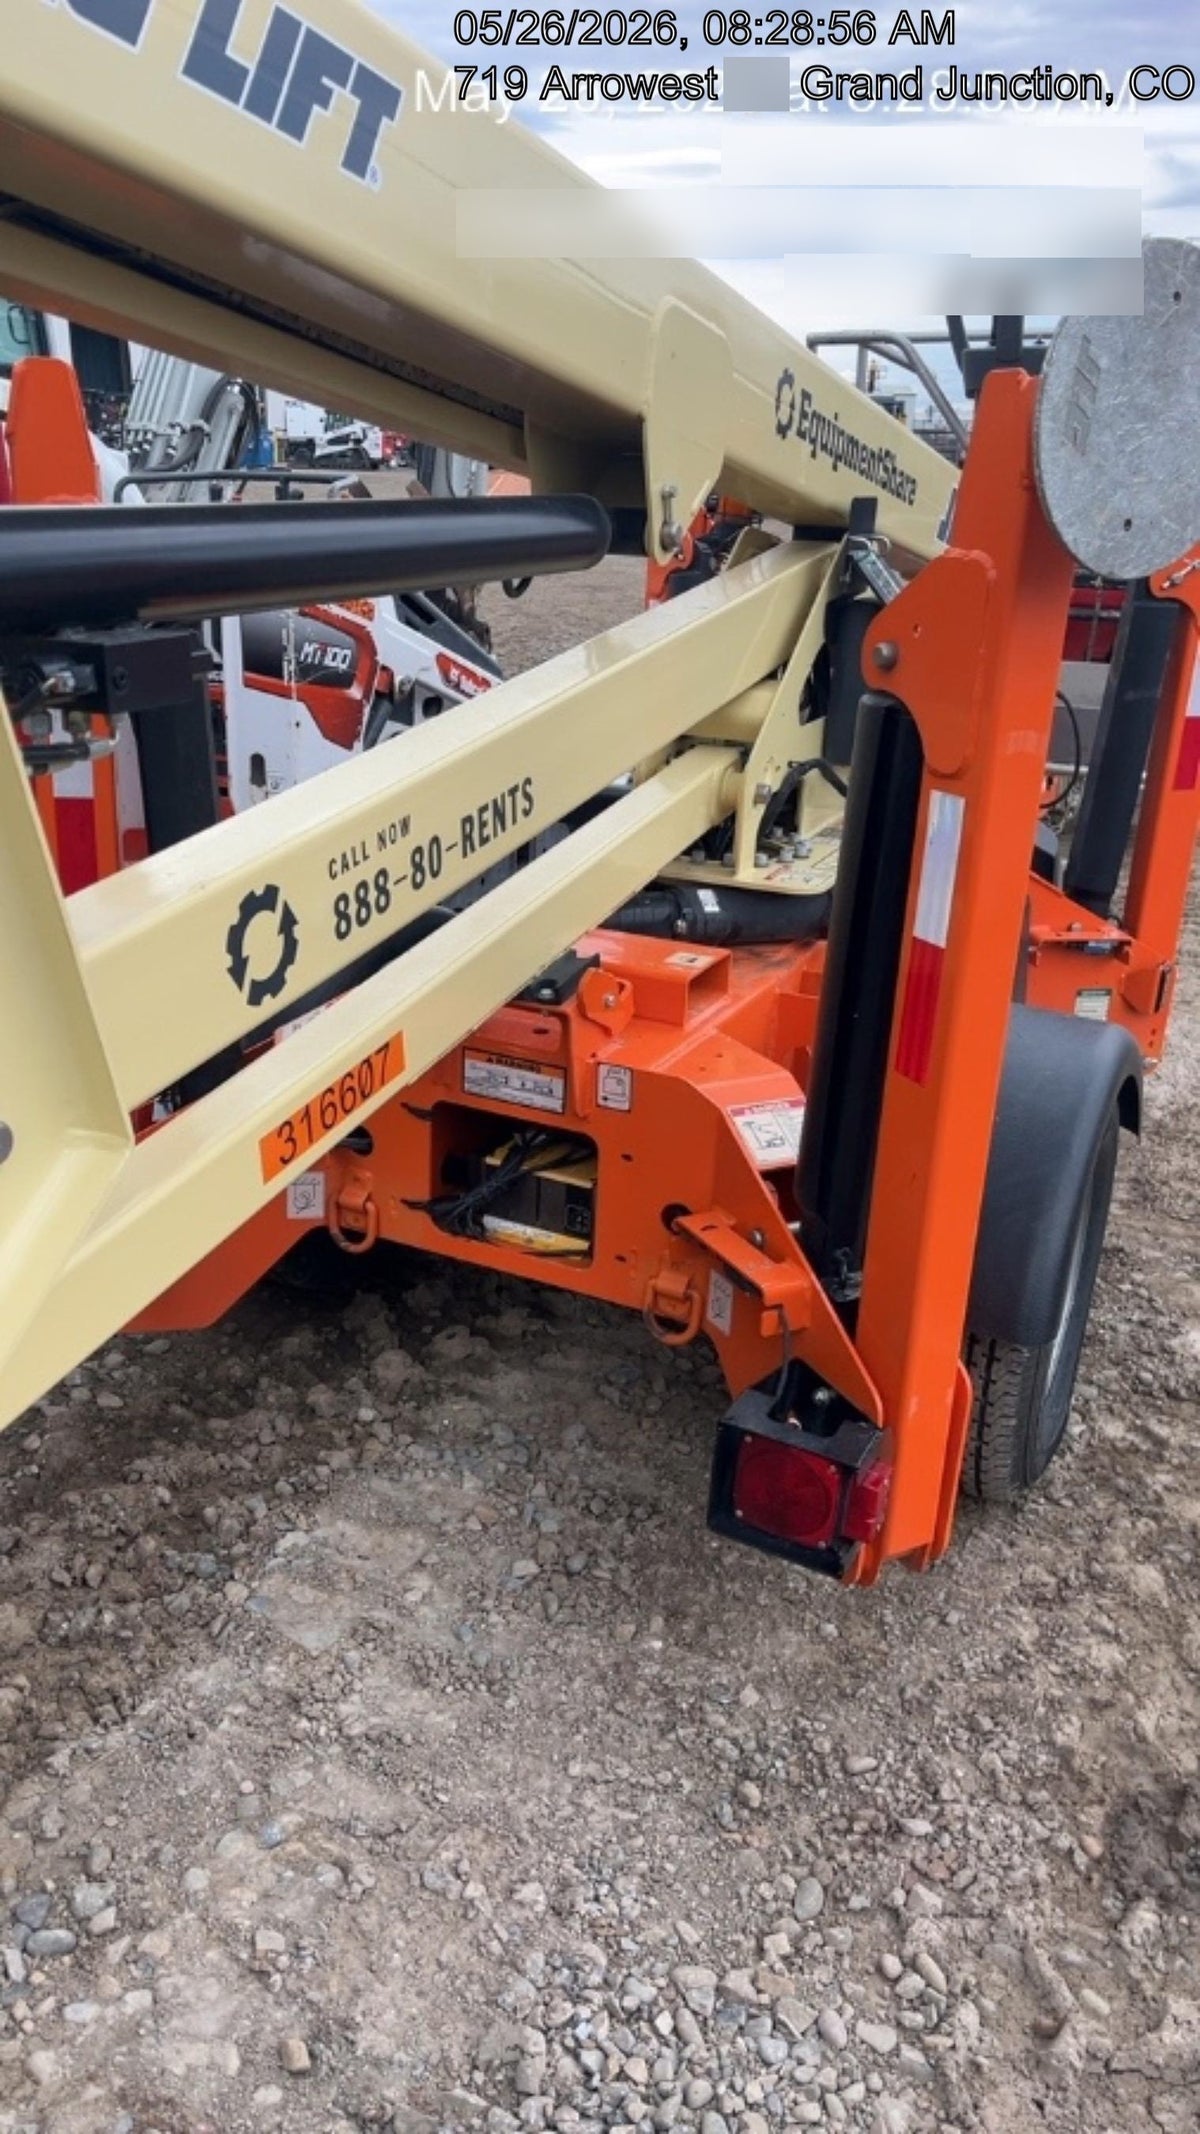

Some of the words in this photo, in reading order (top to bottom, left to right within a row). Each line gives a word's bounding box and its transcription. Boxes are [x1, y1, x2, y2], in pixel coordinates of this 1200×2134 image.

[796, 388, 917, 507] EquipmentShare
[328, 840, 370, 881] CALL
[376, 814, 411, 852] NOW
[333, 777, 534, 941] 888-80-RENTS
[277, 1041, 390, 1166] 316607
